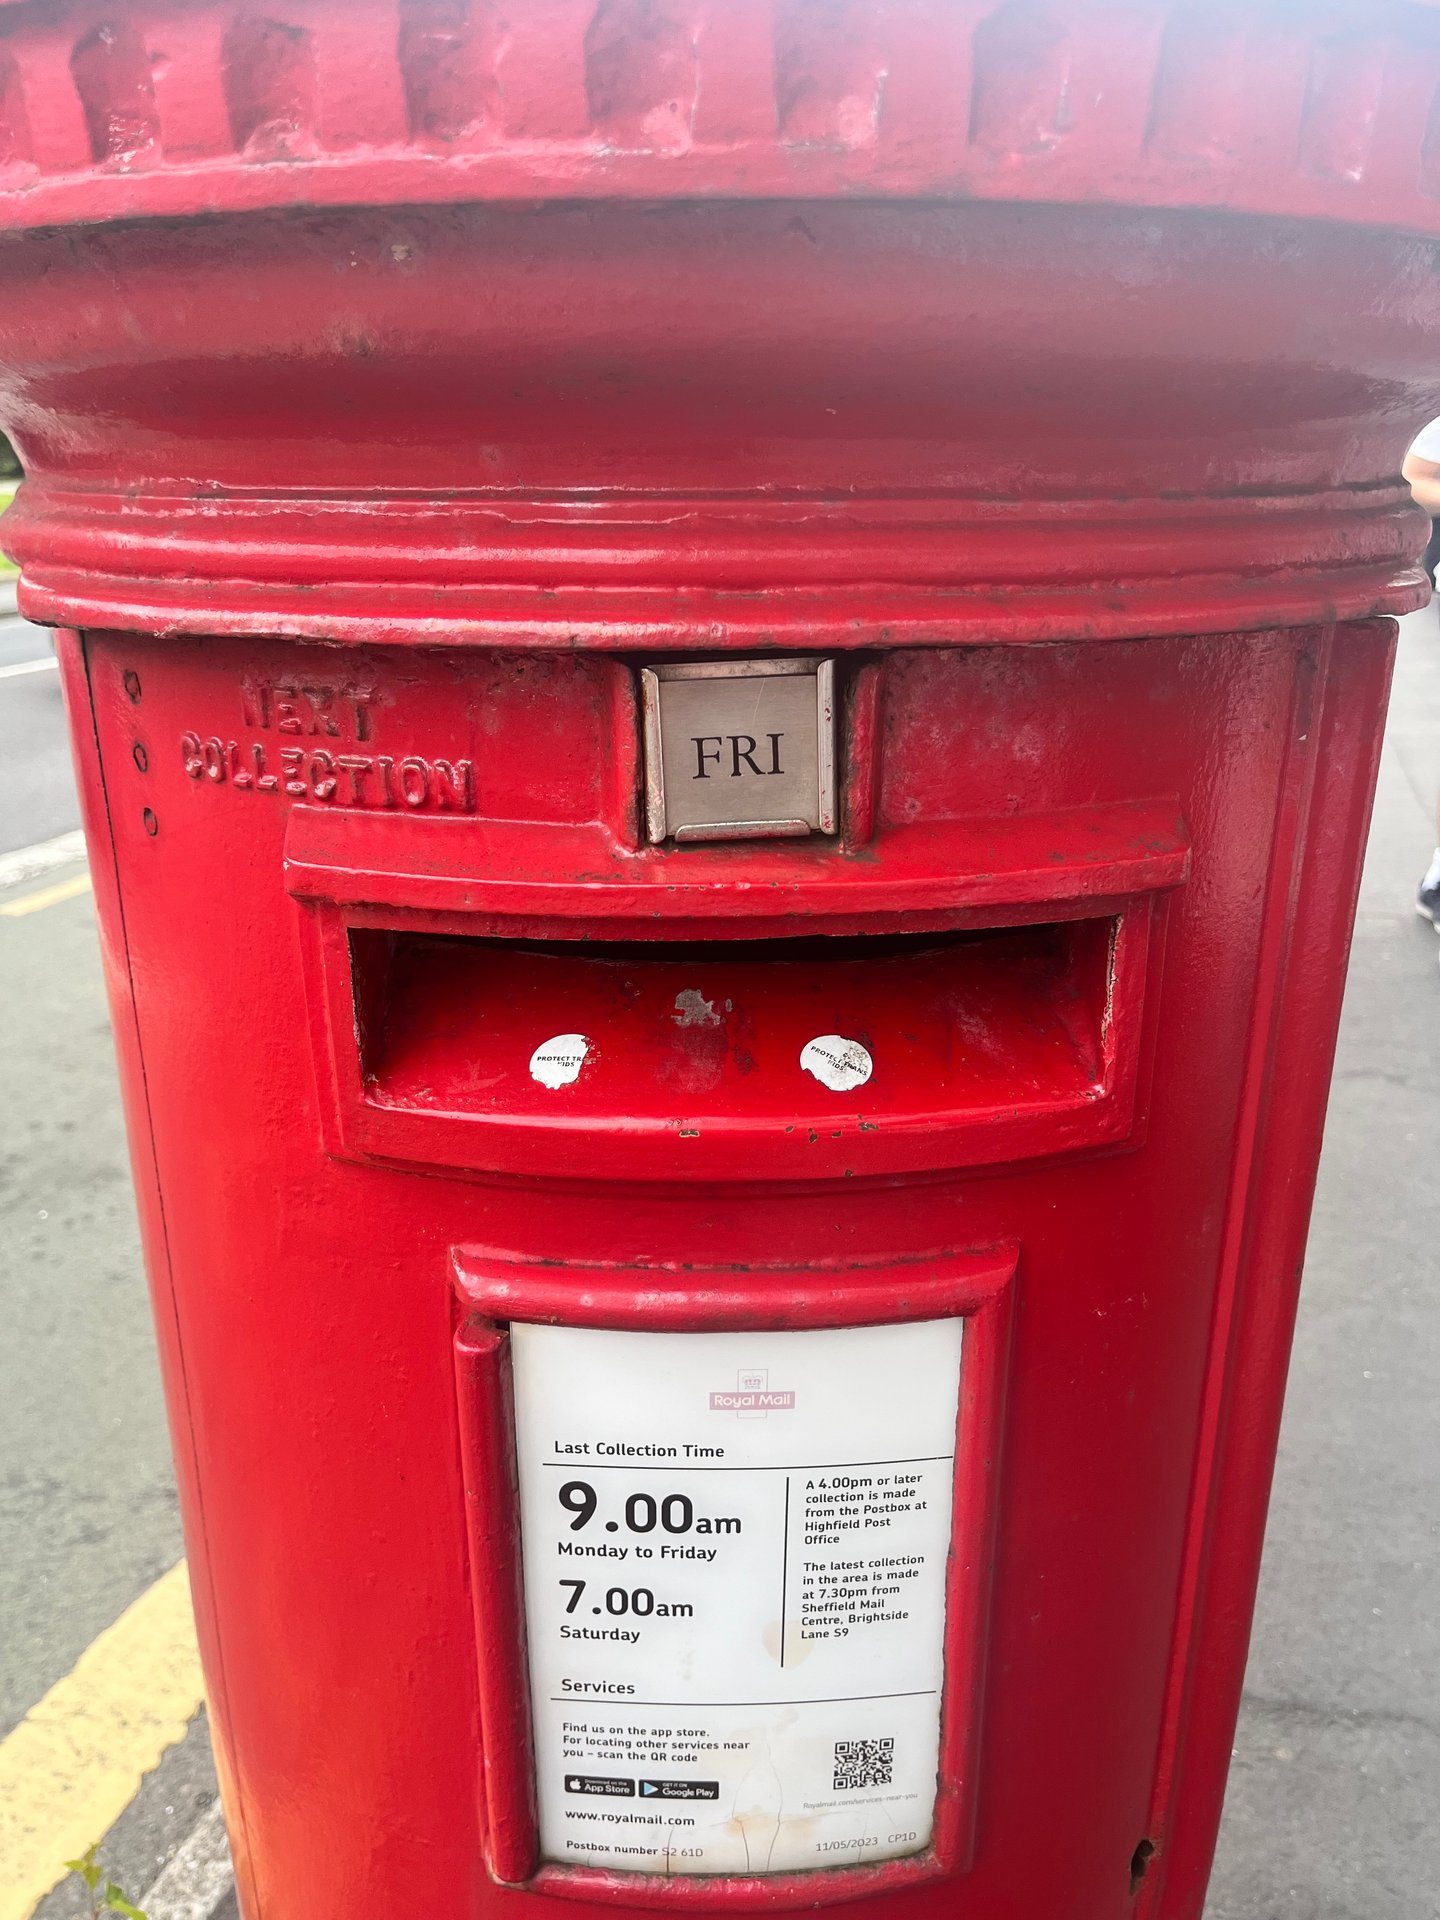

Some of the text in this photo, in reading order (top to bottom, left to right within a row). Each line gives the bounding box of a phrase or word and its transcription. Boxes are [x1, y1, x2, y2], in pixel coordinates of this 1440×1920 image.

[240, 682, 372, 742] NEXT
[690, 733, 784, 779] FRI
[180, 731, 476, 813] COLLECTION
[714, 1393, 791, 1408] Royal Mail
[555, 1441, 725, 1458] Last Collection Time
[806, 1474, 923, 1490] A 4.00pm or later
[806, 1488, 916, 1504] collection is made
[558, 1480, 742, 1534] 9.00am
[805, 1501, 927, 1518] from the Postbox at
[805, 1518, 891, 1533] Highfield Post
[804, 1534, 840, 1545] Office
[558, 1541, 717, 1562] Monday to Friday
[803, 1555, 925, 1572] The latest collection
[803, 1569, 919, 1585] in the area is made
[558, 1579, 694, 1617] 7.00am
[802, 1586, 900, 1600] at 7.30pm from
[802, 1599, 885, 1613] Sheffield Mail
[801, 1610, 909, 1626] Centre, Brightside
[560, 1625, 641, 1644] Saturday
[801, 1627, 849, 1639] Lane S9
[561, 1678, 636, 1695] Services
[562, 1722, 710, 1738] Find us on the app store.
[563, 1735, 750, 1750] For locating other services near
[563, 1749, 584, 1758] you
[597, 1750, 624, 1760] scan
[627, 1752, 647, 1761] the
[650, 1752, 667, 1762] QR
[671, 1753, 698, 1762] code
[584, 1783, 630, 1794] App Store
[662, 1788, 715, 1798] Google Play
[565, 1810, 695, 1826] www.royalmail.com
[566, 1840, 704, 1857] Postbox number S2 61D
[815, 1832, 917, 1852] 11/05/2023 CP1D
